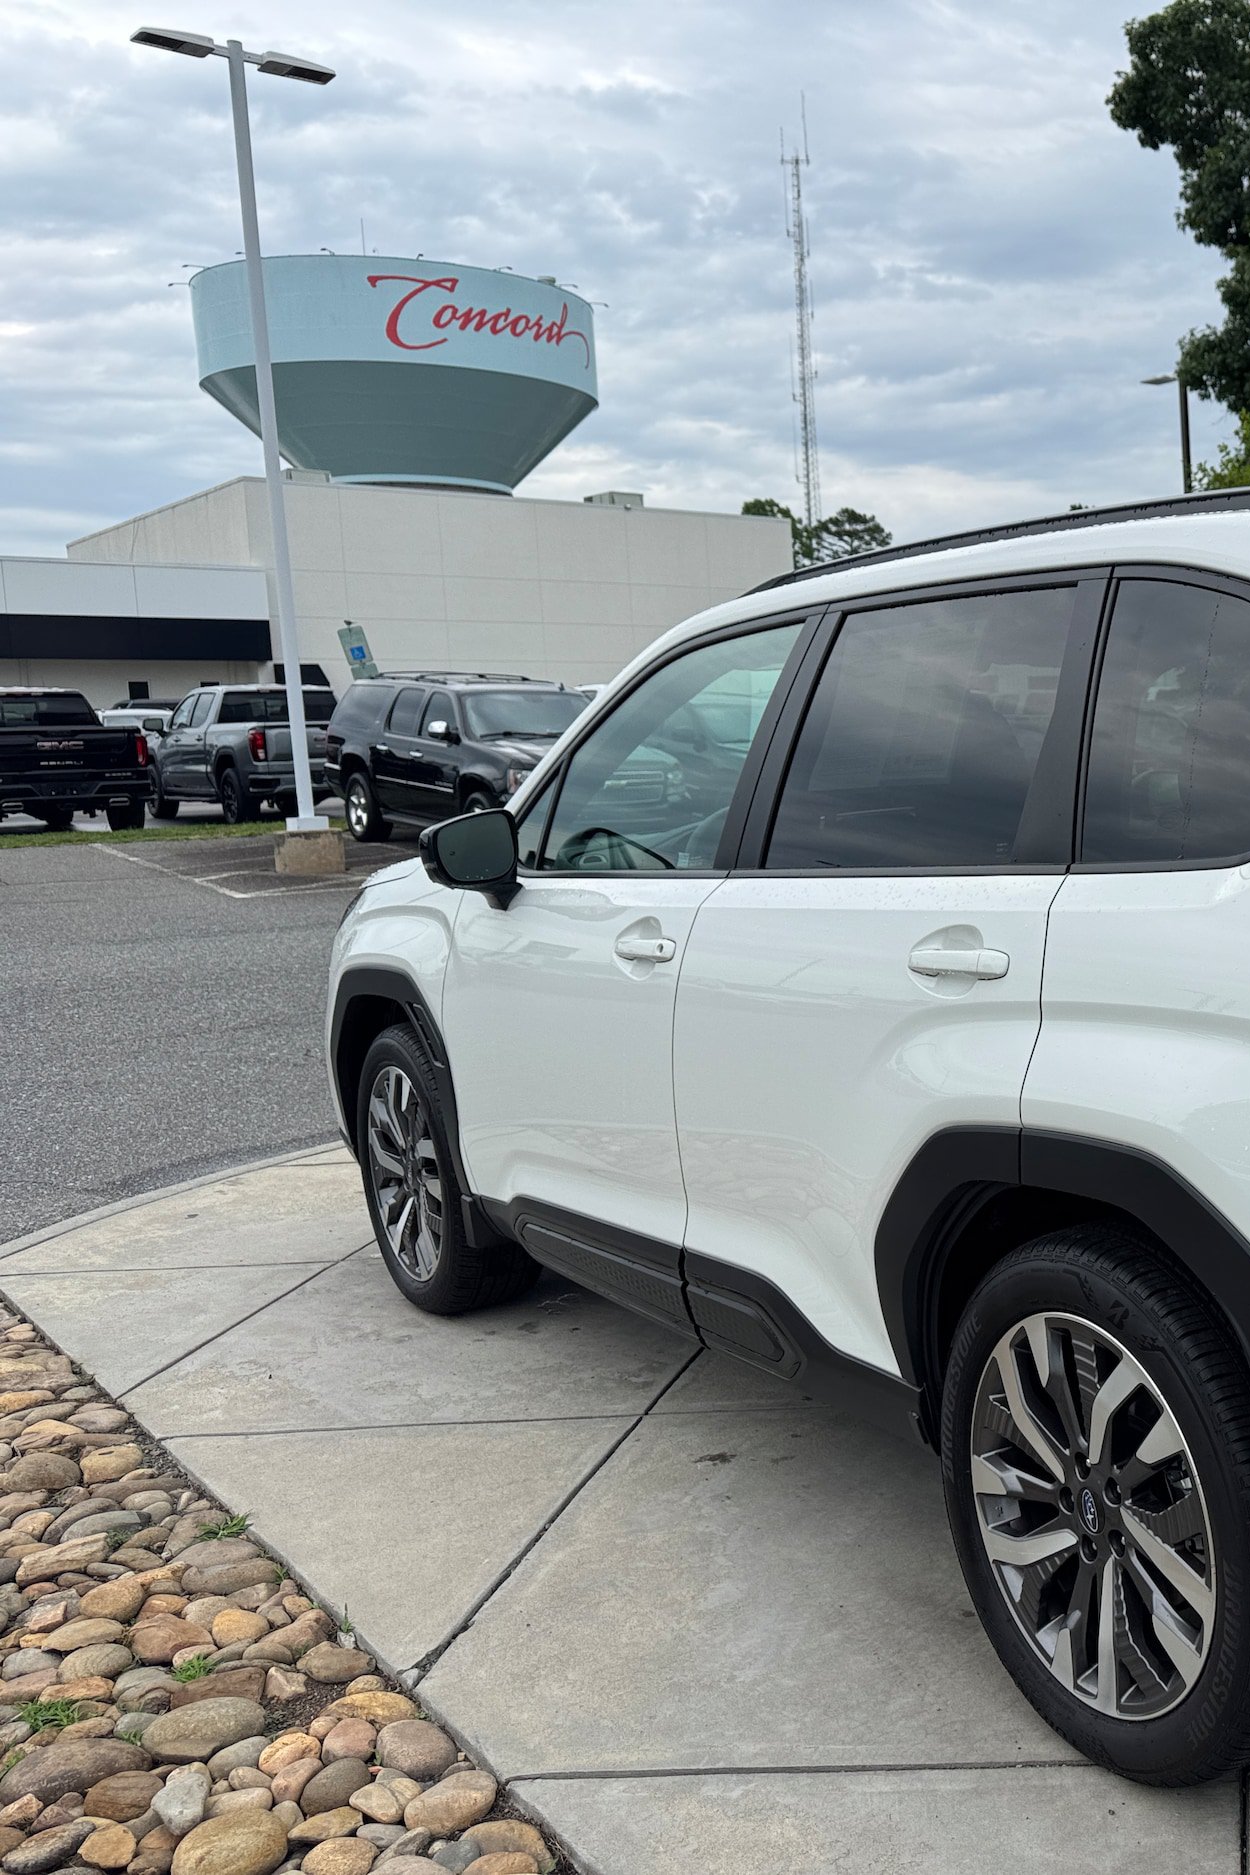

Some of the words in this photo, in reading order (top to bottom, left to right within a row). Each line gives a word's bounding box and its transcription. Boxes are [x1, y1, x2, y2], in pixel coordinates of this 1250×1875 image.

[367, 275, 590, 370] Concord
[37, 741, 84, 750] GMC
[942, 1310, 983, 1484] BRIDGESTONE
[1185, 1557, 1245, 1751] BRIDGESTONE
